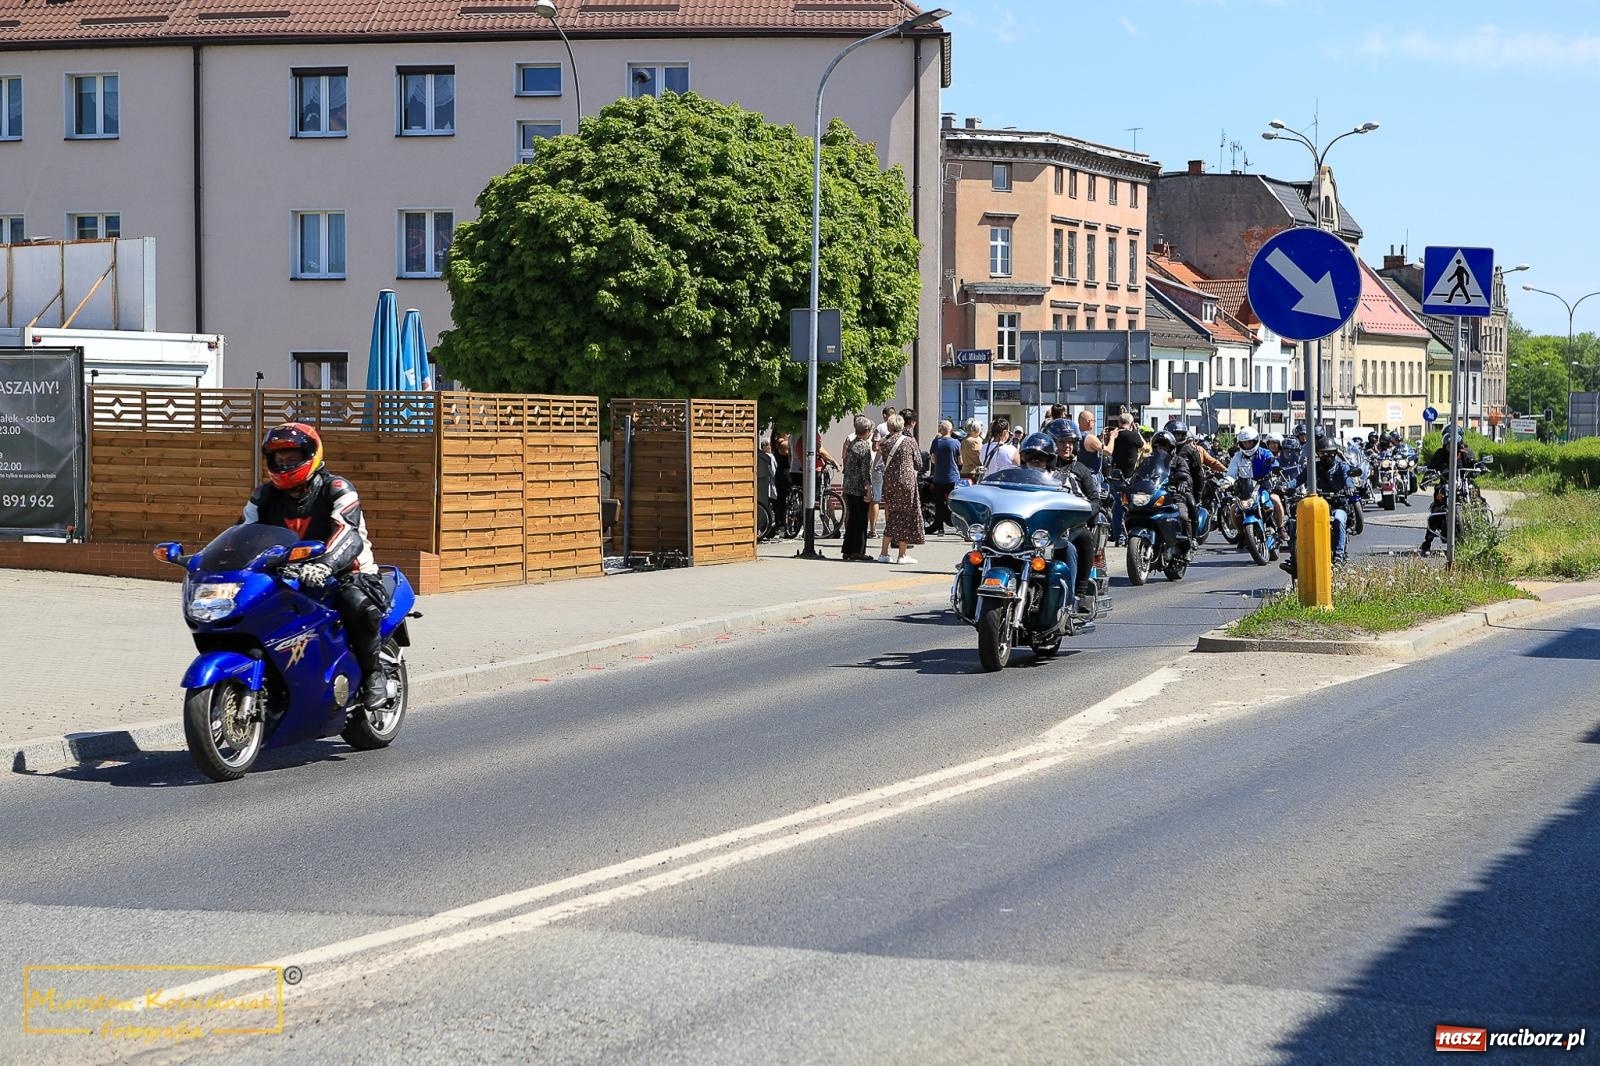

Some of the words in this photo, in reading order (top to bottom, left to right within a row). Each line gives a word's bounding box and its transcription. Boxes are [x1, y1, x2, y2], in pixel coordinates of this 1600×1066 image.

[26, 413, 56, 424] sobota
[2, 494, 26, 507] 891
[29, 494, 55, 508] 962
